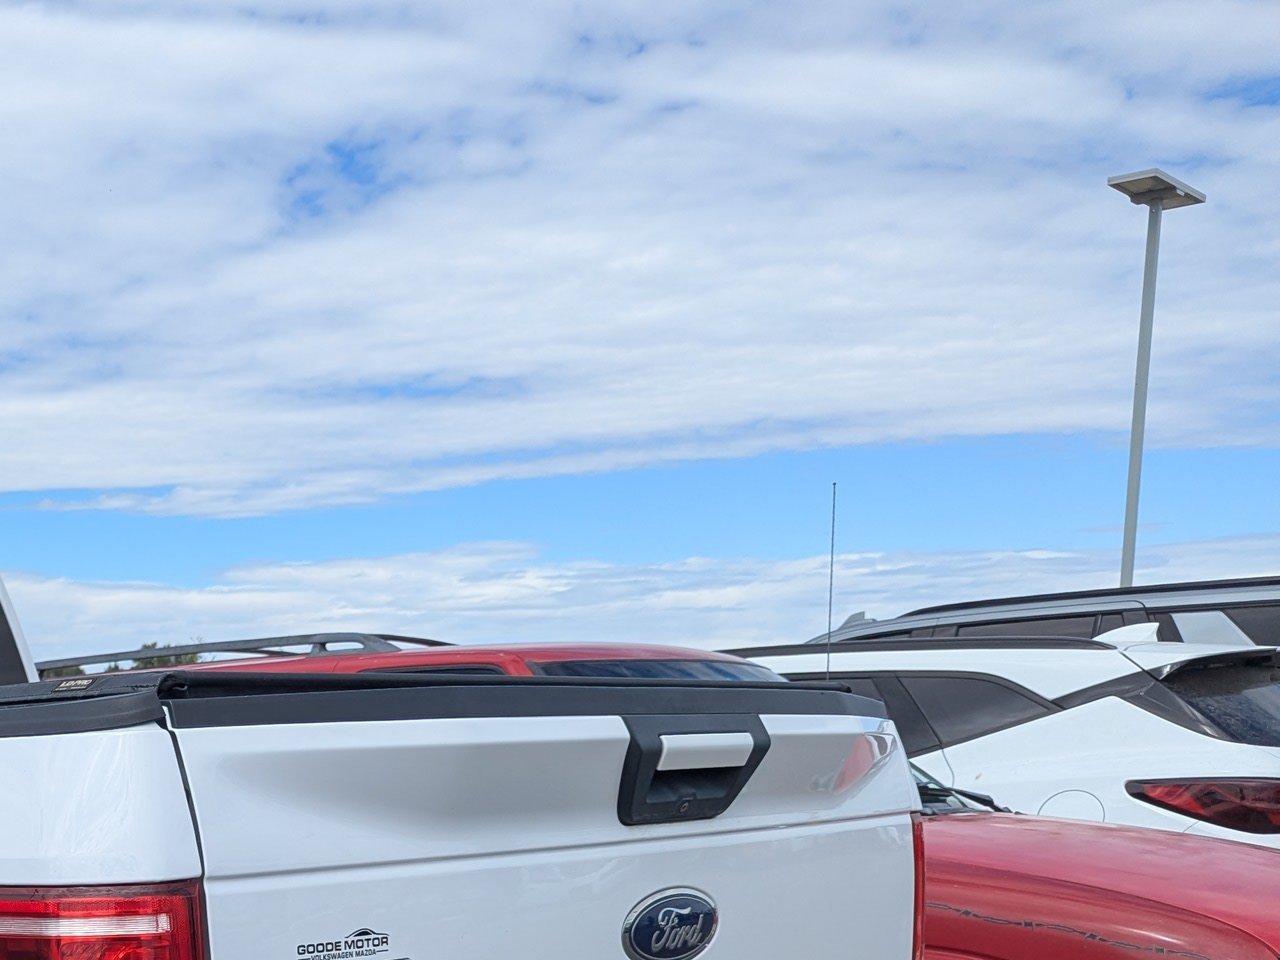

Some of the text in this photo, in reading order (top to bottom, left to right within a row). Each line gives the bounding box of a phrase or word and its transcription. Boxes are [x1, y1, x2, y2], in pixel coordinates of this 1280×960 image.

[651, 906, 705, 953] Ford
[297, 936, 389, 956] GOODE MOTOR
[355, 948, 377, 958] MAZDA
